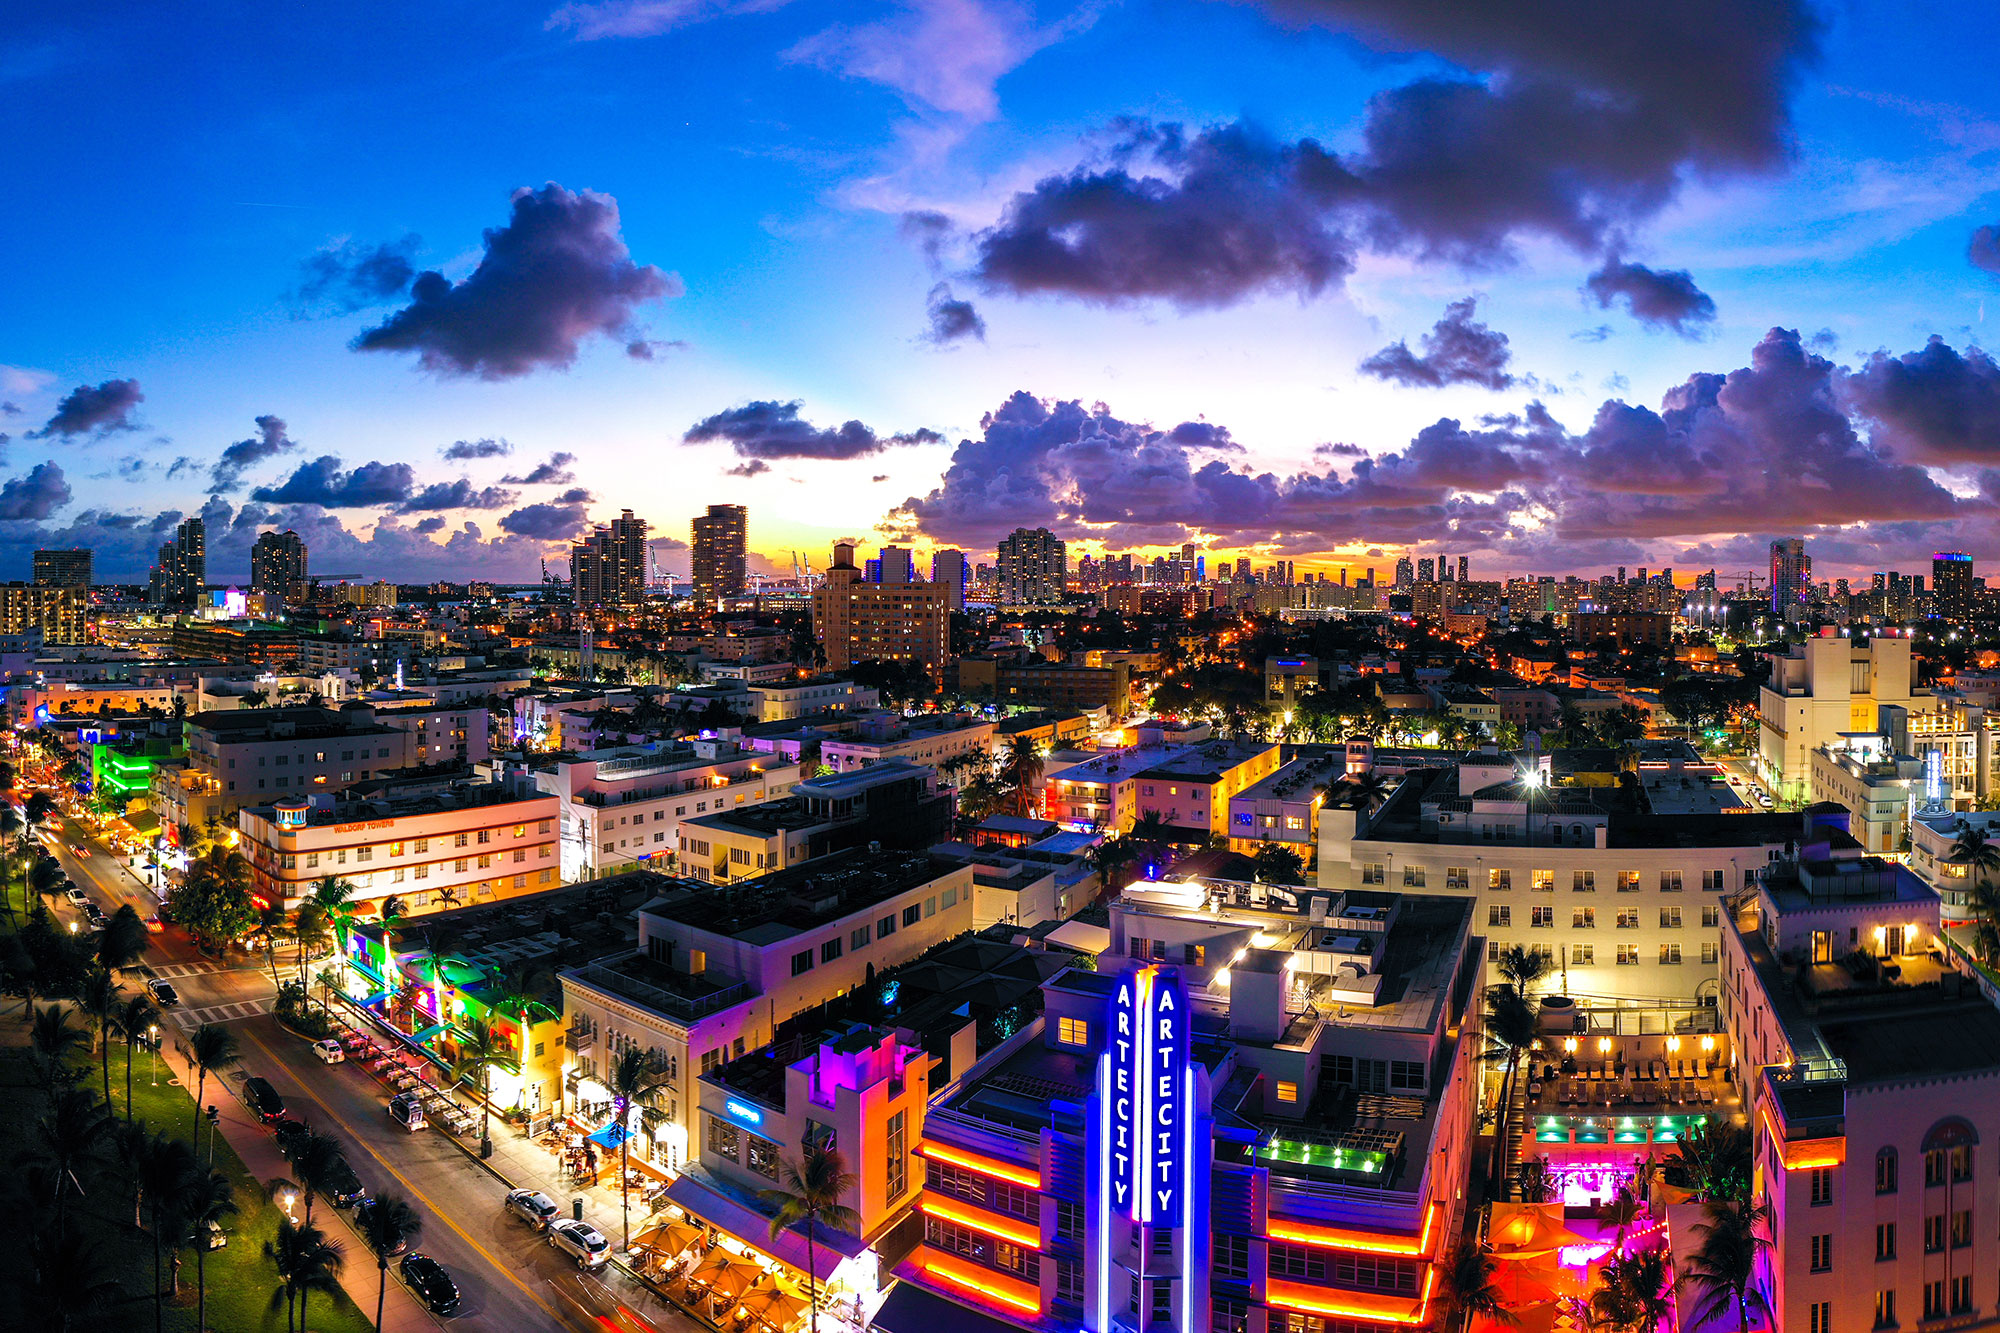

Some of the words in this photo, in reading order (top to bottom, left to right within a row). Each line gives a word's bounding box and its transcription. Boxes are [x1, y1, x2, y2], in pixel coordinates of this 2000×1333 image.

[367, 819, 395, 829] TOWERS
[1114, 984, 1131, 1204] ARTECITY
[1157, 989, 1175, 1211] ARTECITY
